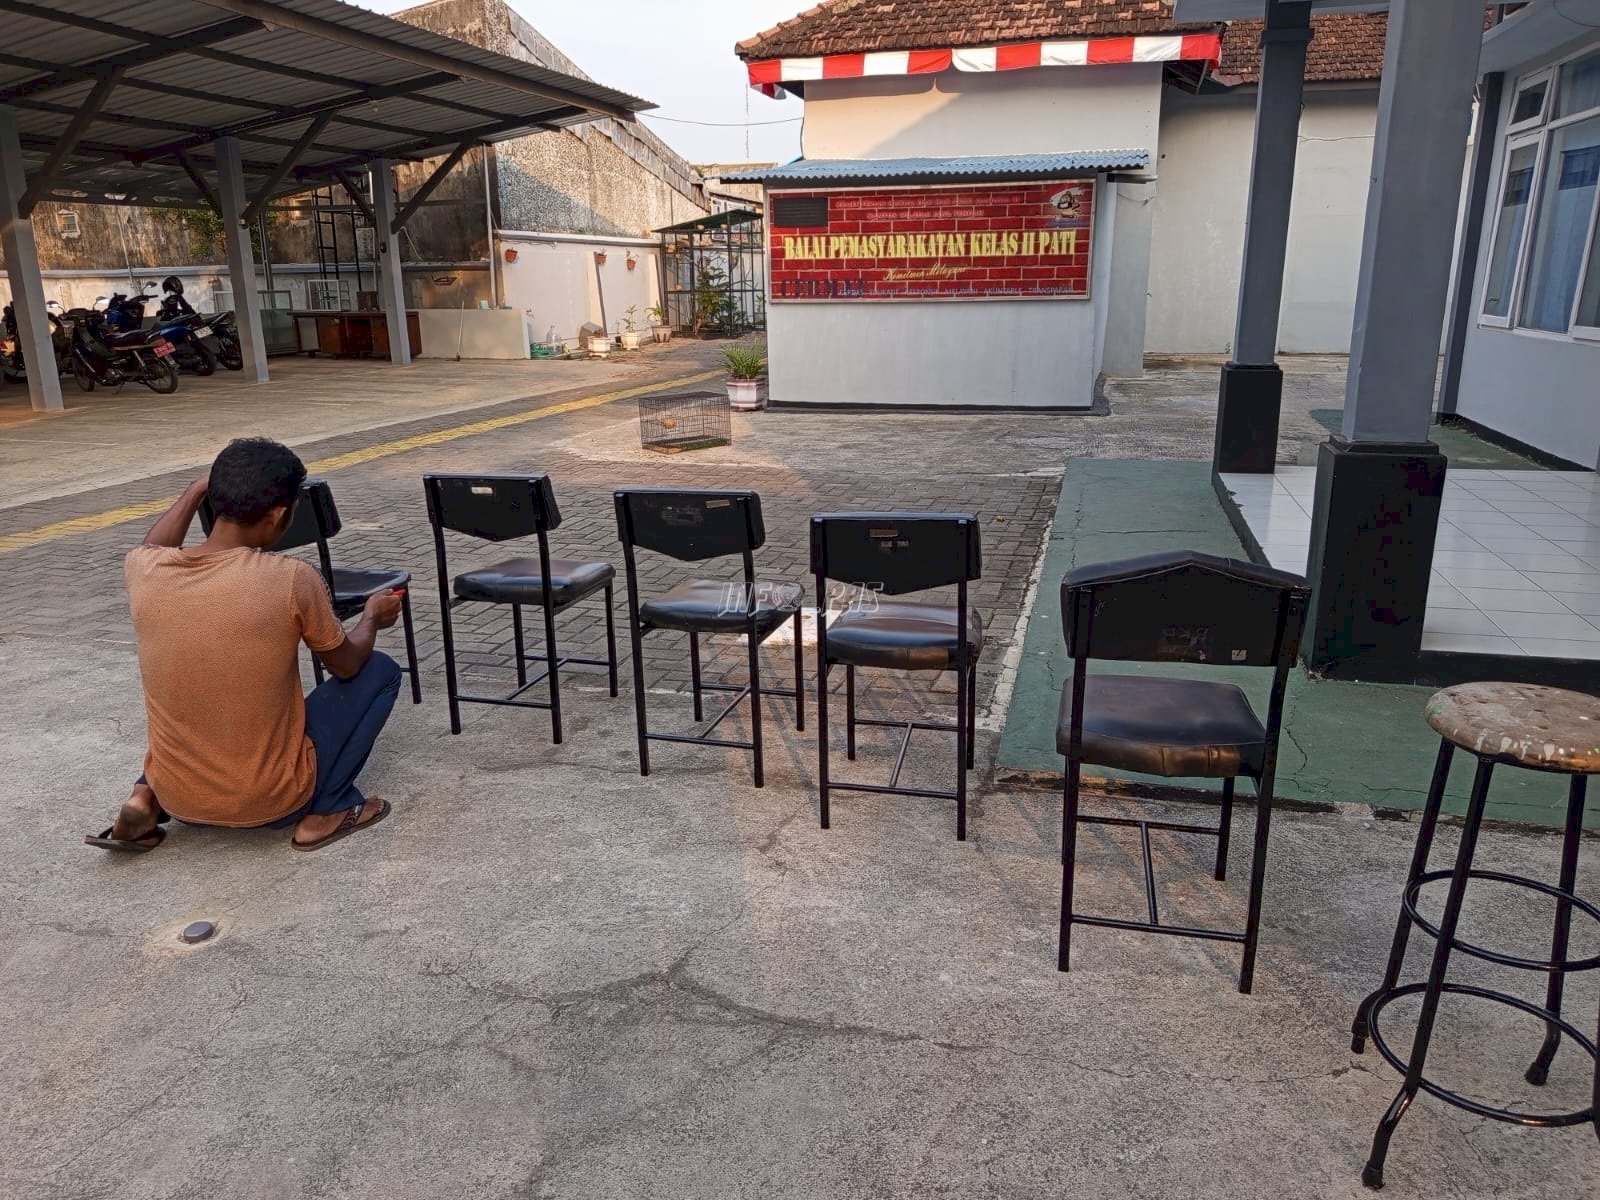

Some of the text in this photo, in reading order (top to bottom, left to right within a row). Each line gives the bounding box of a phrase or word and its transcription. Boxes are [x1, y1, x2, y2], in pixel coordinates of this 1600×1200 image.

[785, 229, 1077, 260] BALAI PEMASYARAKATAN KELAS II PATI
